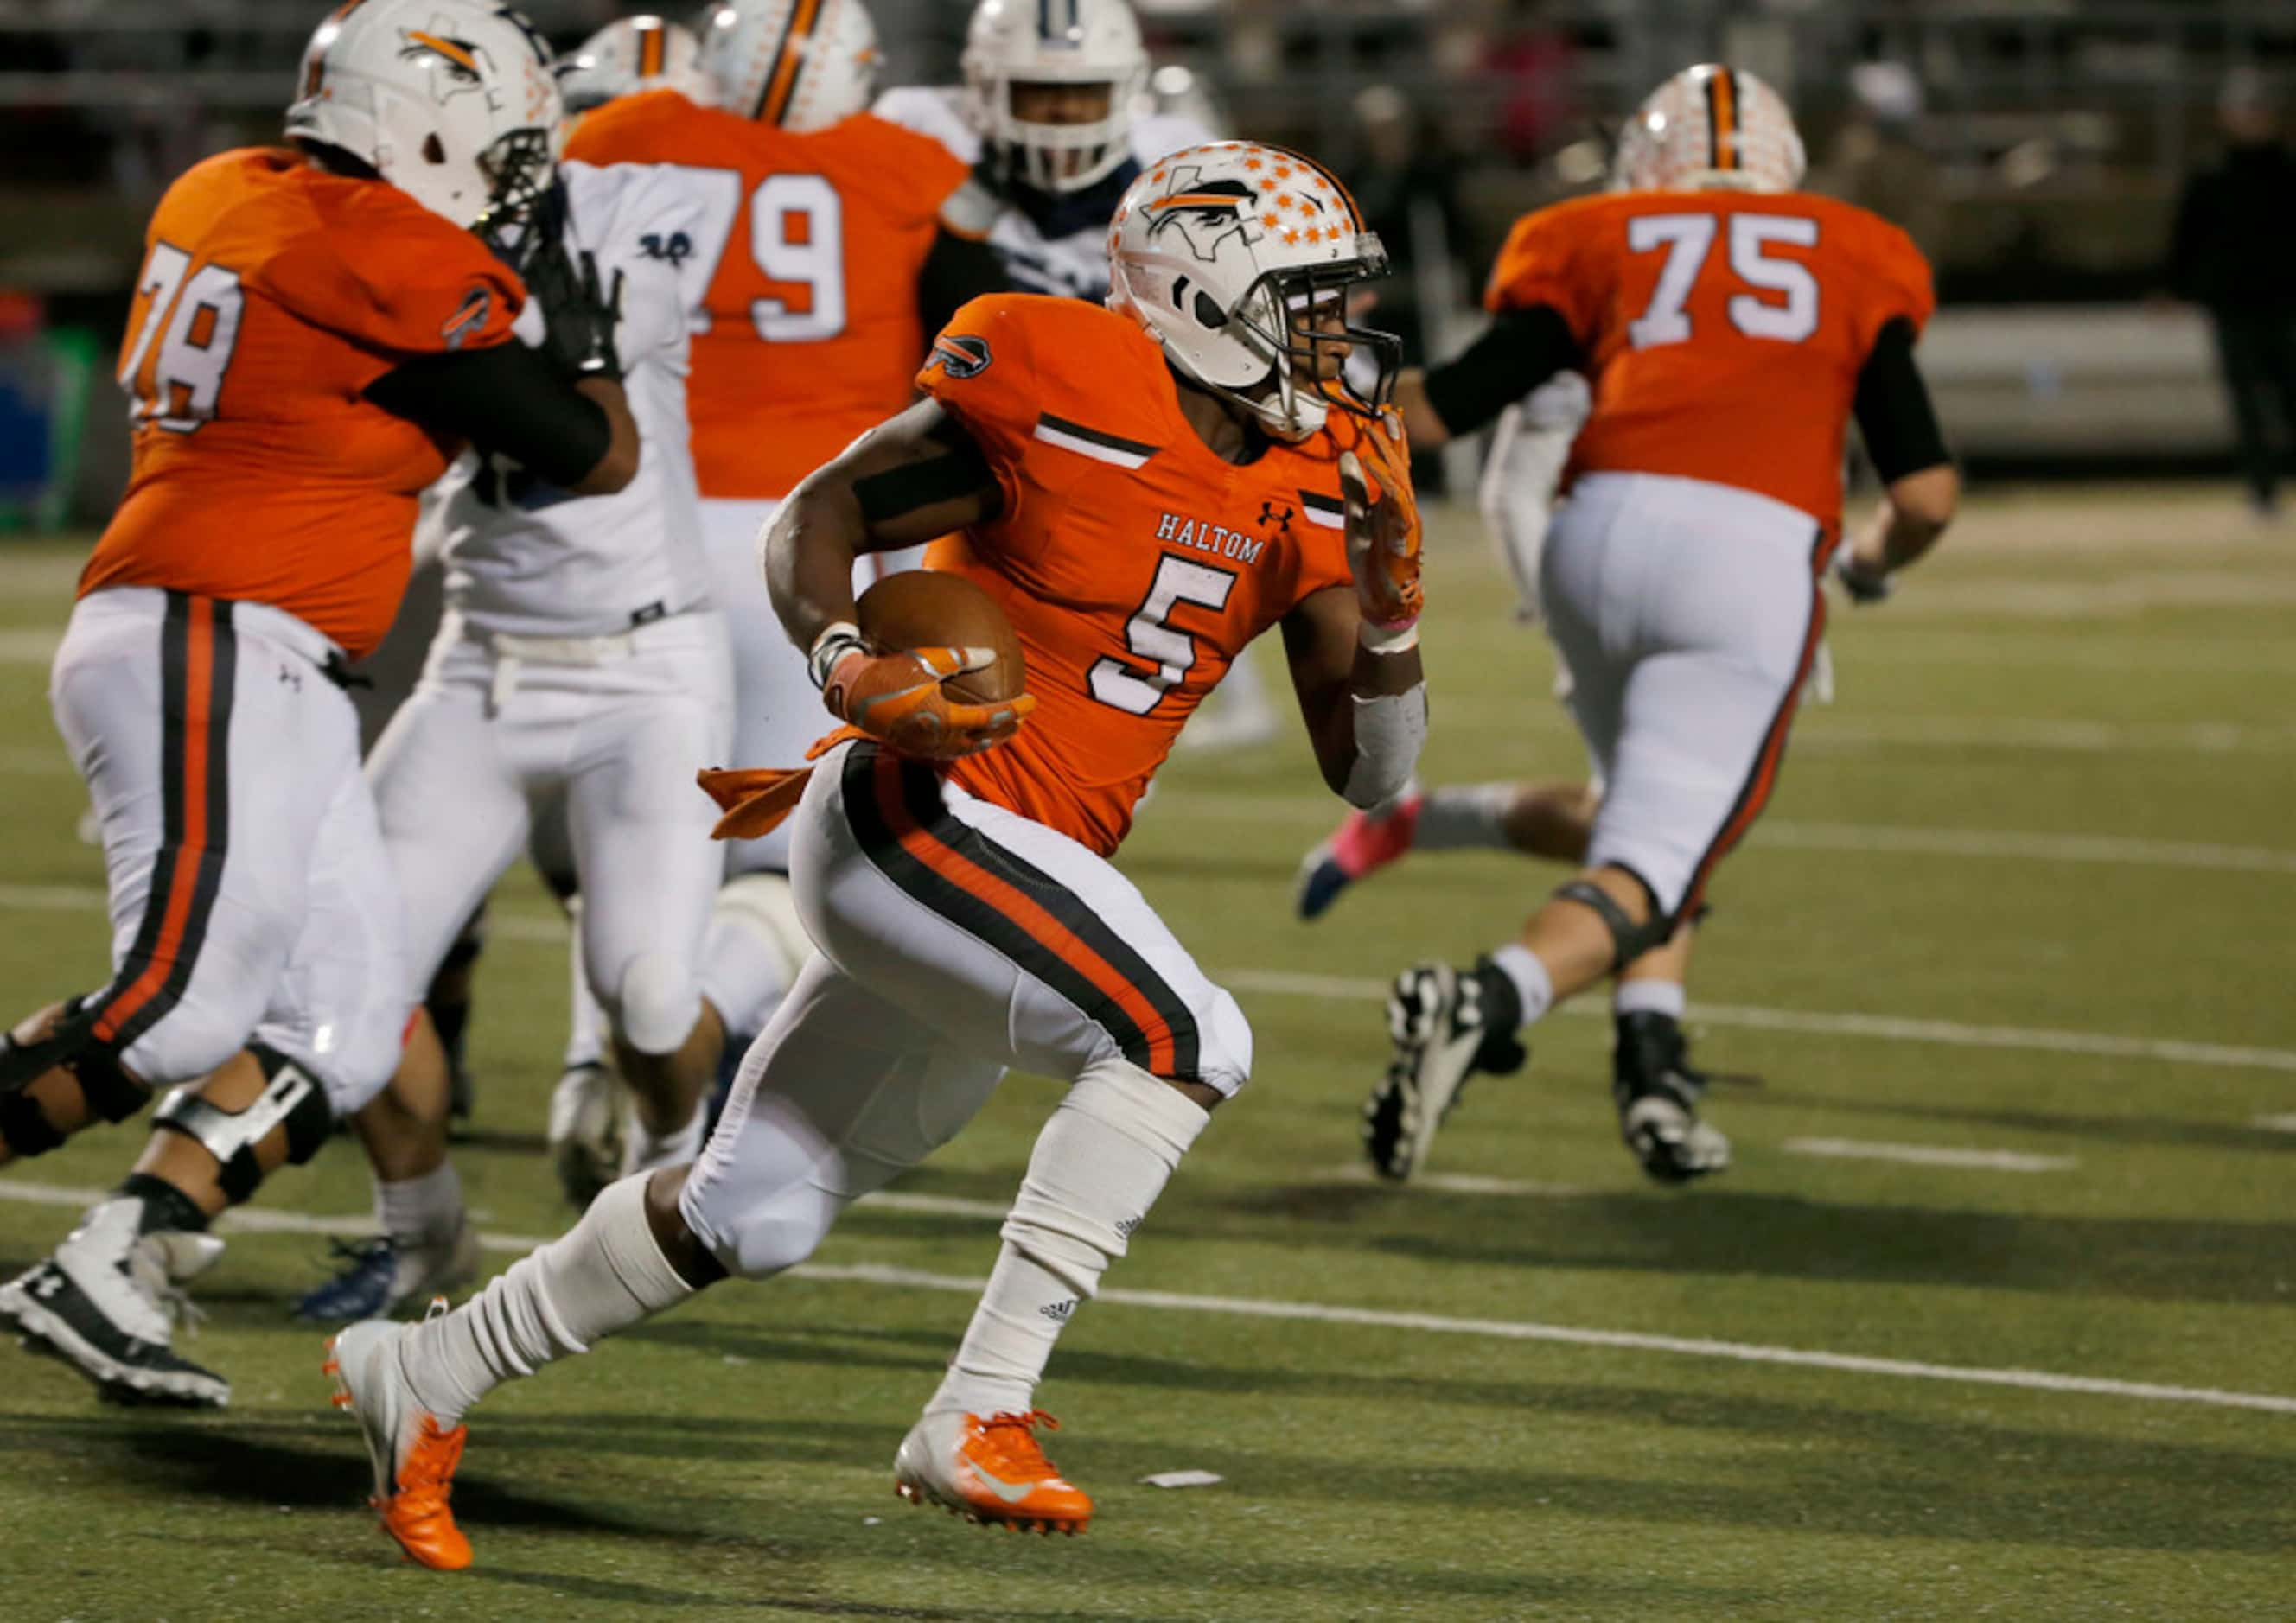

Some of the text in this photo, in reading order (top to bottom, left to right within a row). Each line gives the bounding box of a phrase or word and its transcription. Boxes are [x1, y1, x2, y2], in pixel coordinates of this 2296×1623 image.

[677, 164, 847, 342] 79
[1627, 213, 1821, 351] 75
[118, 238, 246, 434] 78
[1156, 513, 1264, 564] HALTOM
[1087, 551, 1240, 716] 5
